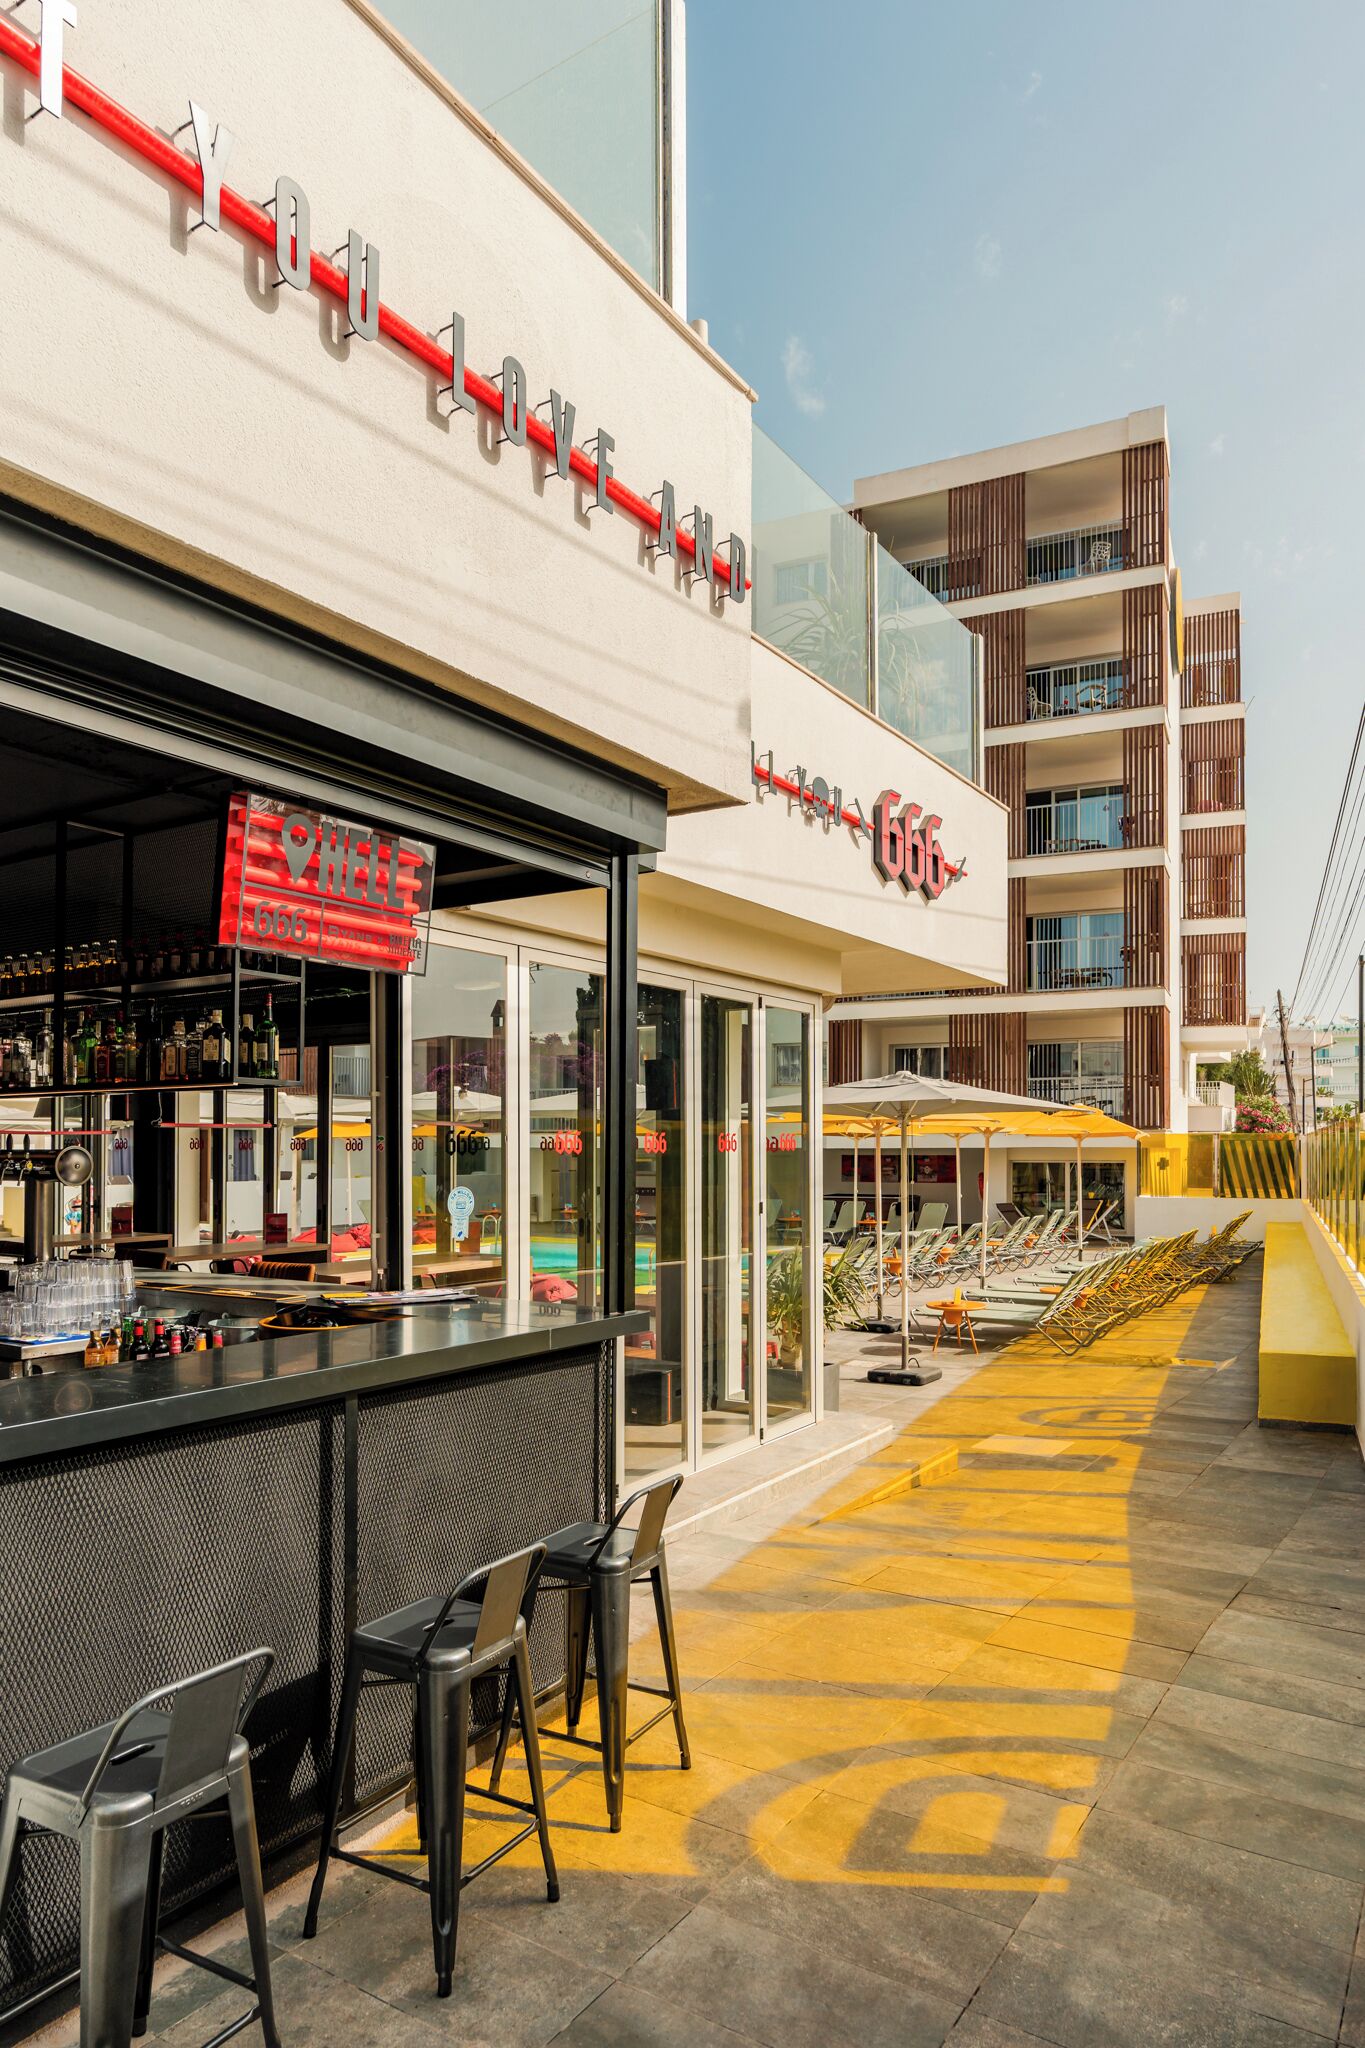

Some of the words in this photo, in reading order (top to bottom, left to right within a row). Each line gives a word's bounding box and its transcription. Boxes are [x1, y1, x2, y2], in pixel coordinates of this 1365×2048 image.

[188, 100, 380, 342] YOU
[452, 311, 615, 515] LOVE
[658, 480, 746, 604] AND
[873, 789, 946, 901] 666
[318, 821, 405, 909] HELL
[254, 900, 308, 943] 666
[445, 1130, 478, 1156] 666
[555, 1130, 583, 1155] 666
[643, 1131, 667, 1153] 666
[717, 1132, 737, 1153] 666
[779, 1132, 797, 1152] 666
